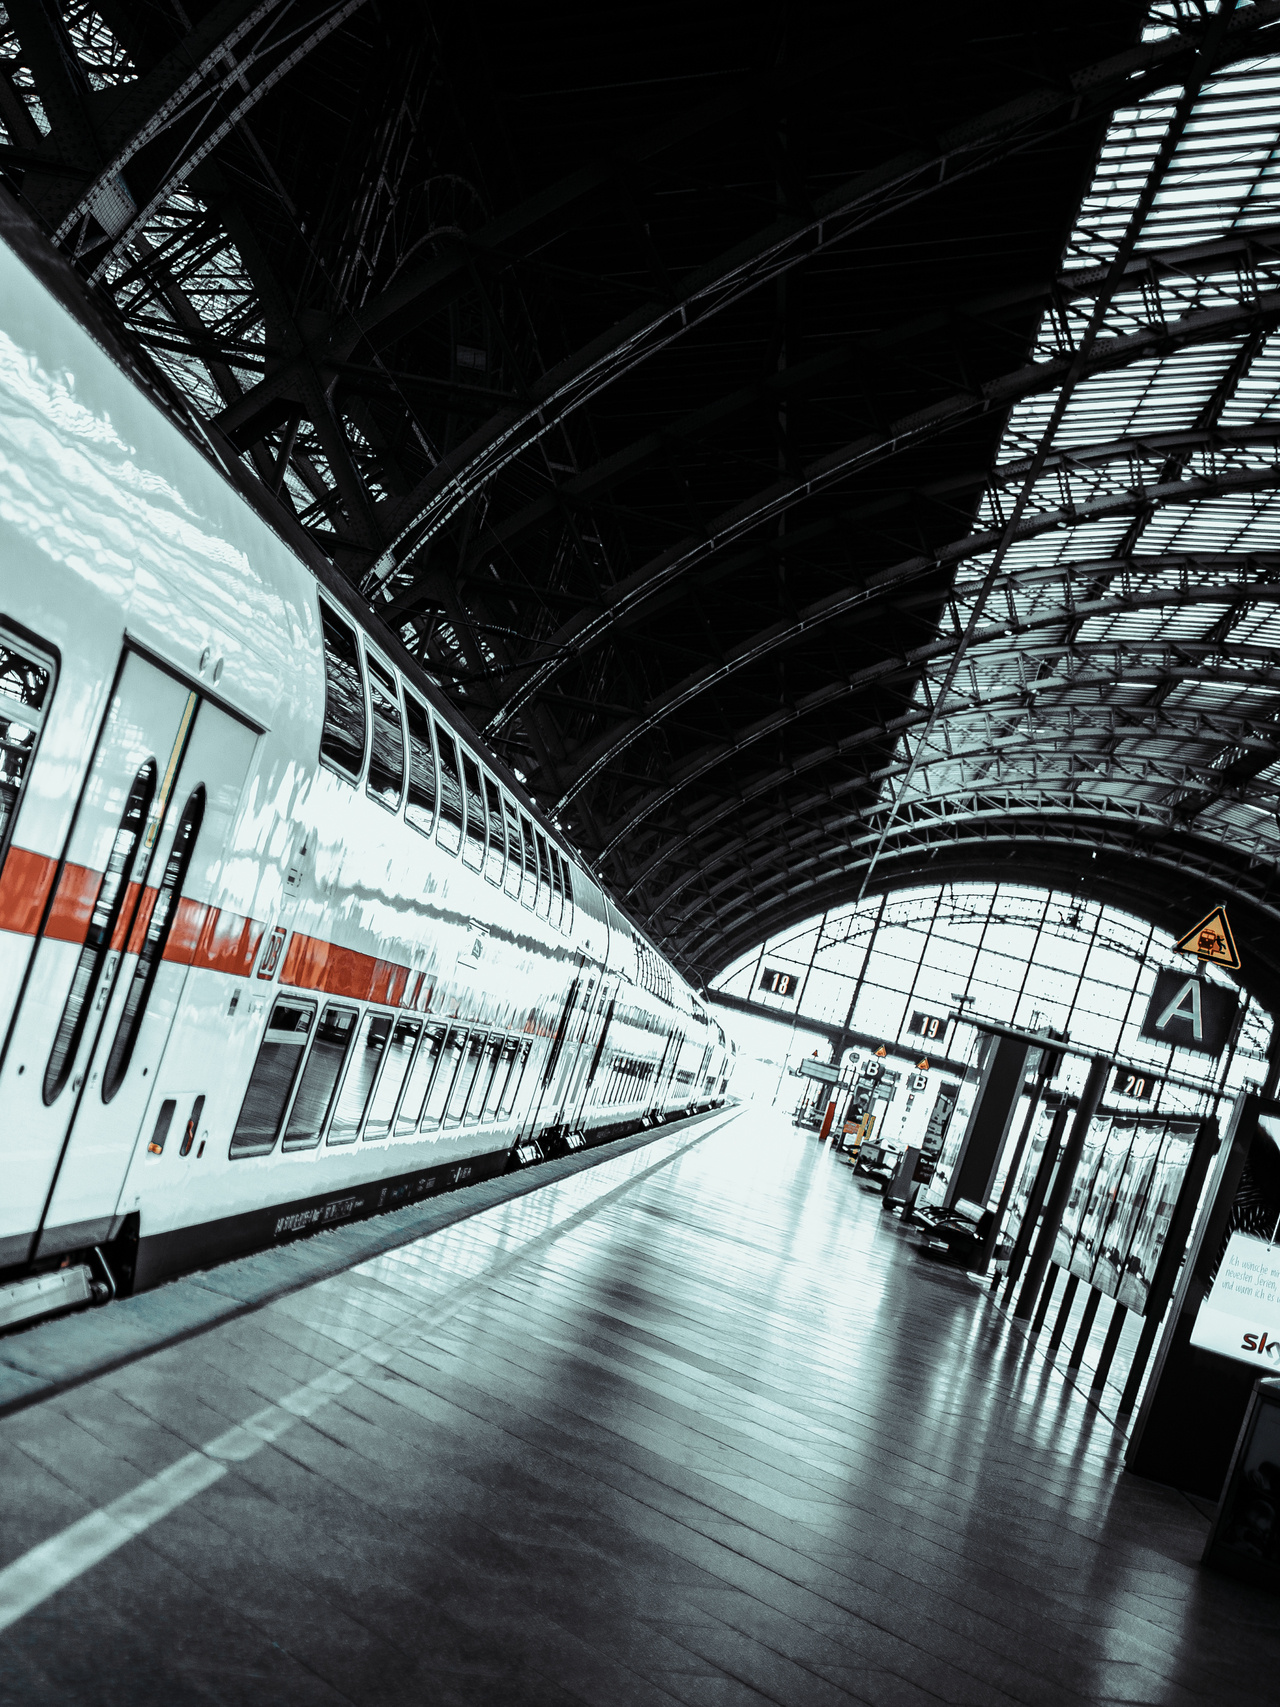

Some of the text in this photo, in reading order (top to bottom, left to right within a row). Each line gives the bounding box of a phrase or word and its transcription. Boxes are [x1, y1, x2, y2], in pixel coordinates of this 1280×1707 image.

[771, 972, 790, 995] 18
[1155, 978, 1203, 1041] A
[920, 1015, 940, 1038] 19
[866, 1061, 880, 1076] B
[913, 1074, 927, 1091] B
[1123, 1075, 1145, 1098] 20
[1229, 1254, 1240, 1267] Ich
[1225, 1268, 1253, 1283] neuesten
[1221, 1281, 1234, 1291] und
[1254, 1288, 1265, 1299] ich
[1267, 1292, 1275, 1302] es
